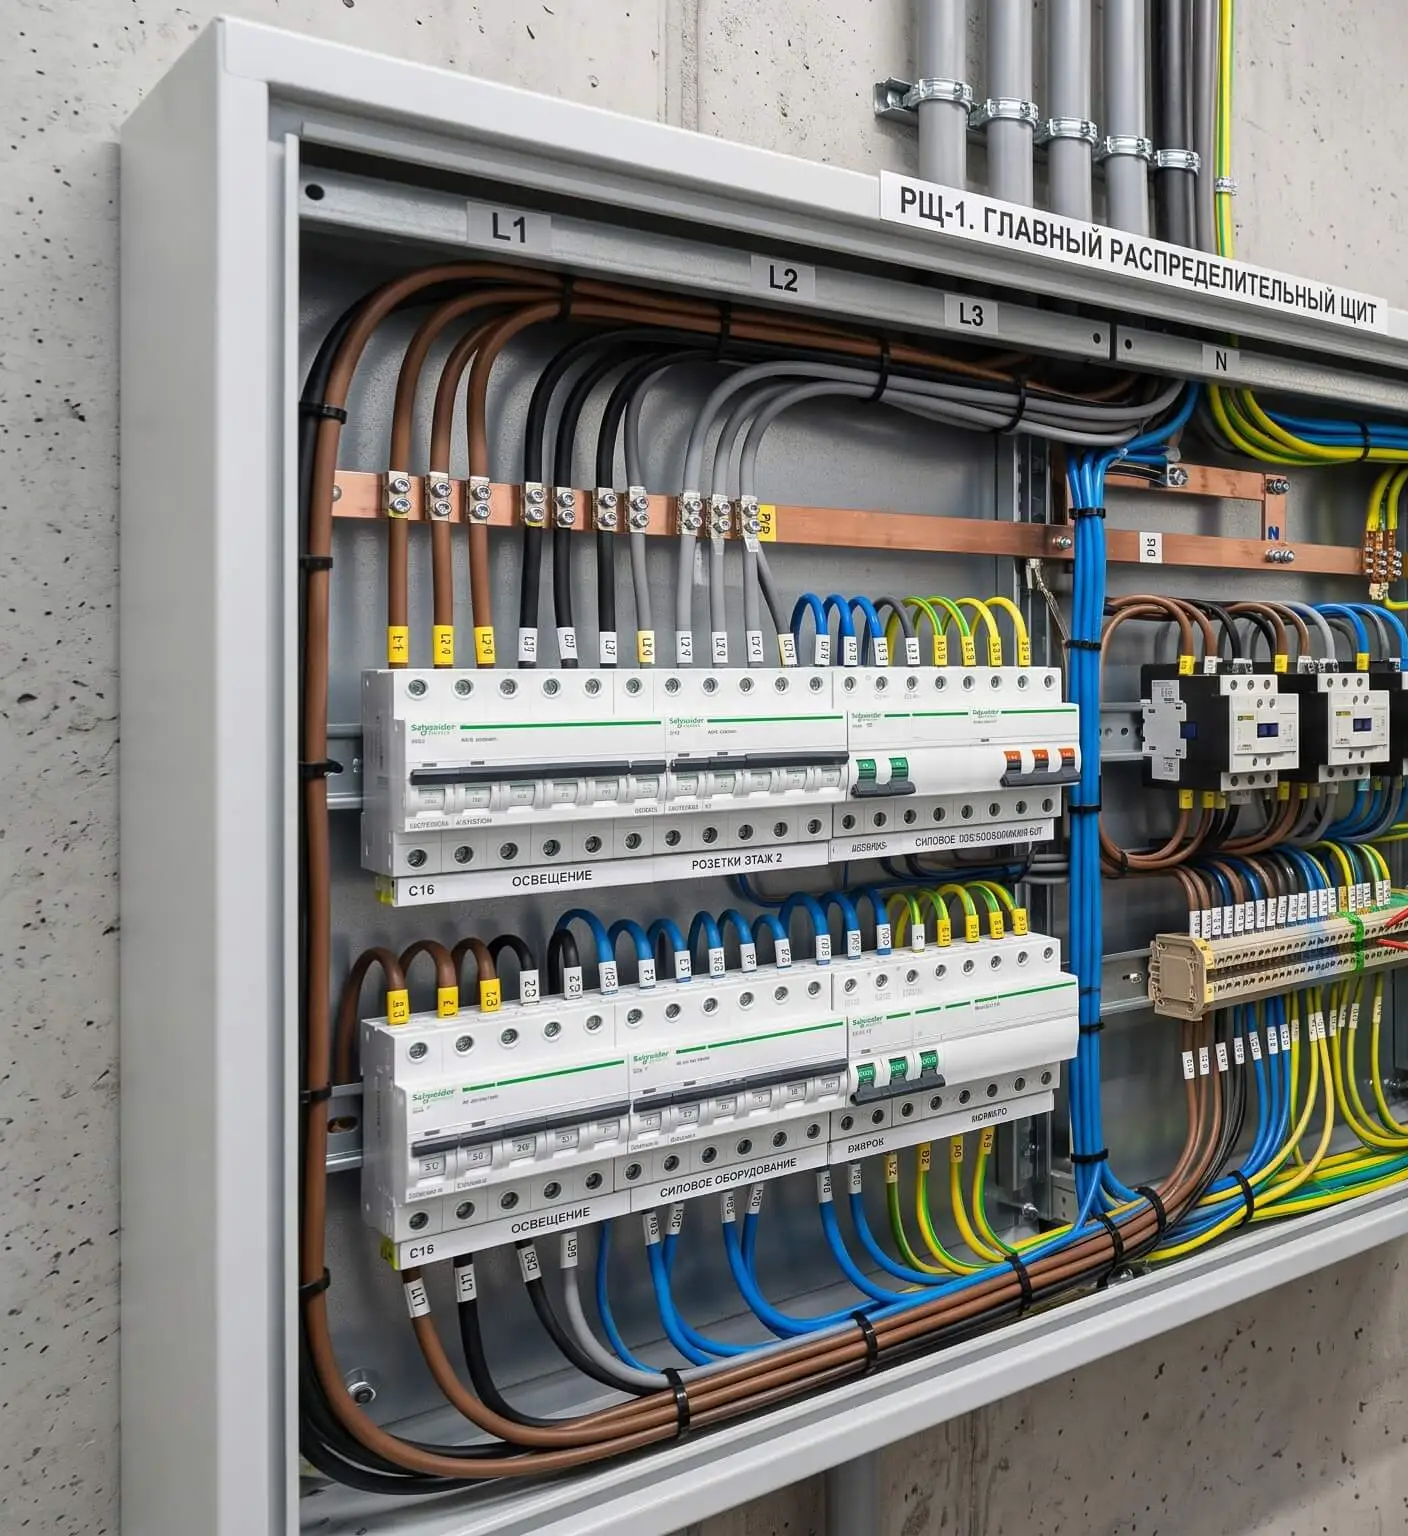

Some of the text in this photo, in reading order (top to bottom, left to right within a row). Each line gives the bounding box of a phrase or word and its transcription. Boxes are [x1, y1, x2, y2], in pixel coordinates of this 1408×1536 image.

[491, 212, 527, 244] L1
[900, 186, 1377, 325] РЩ-1. ГЛАВНЫЙ РАСПРЕДЕЛИТЕЛЬНЫЙ ЩИТ
[769, 264, 798, 292] L2
[959, 302, 984, 327] L3
[1215, 351, 1227, 371] N
[1268, 526, 1280, 540] N
[692, 856, 741, 870] РОЗЕТКИ
[776, 853, 782, 862] 2
[512, 869, 593, 888] ОСВЕЩЕНИЕ
[715, 1158, 797, 1185] ОБОРУДОВАНИЕ
[511, 1206, 591, 1234] ОСВЕЩЕНИЕ
